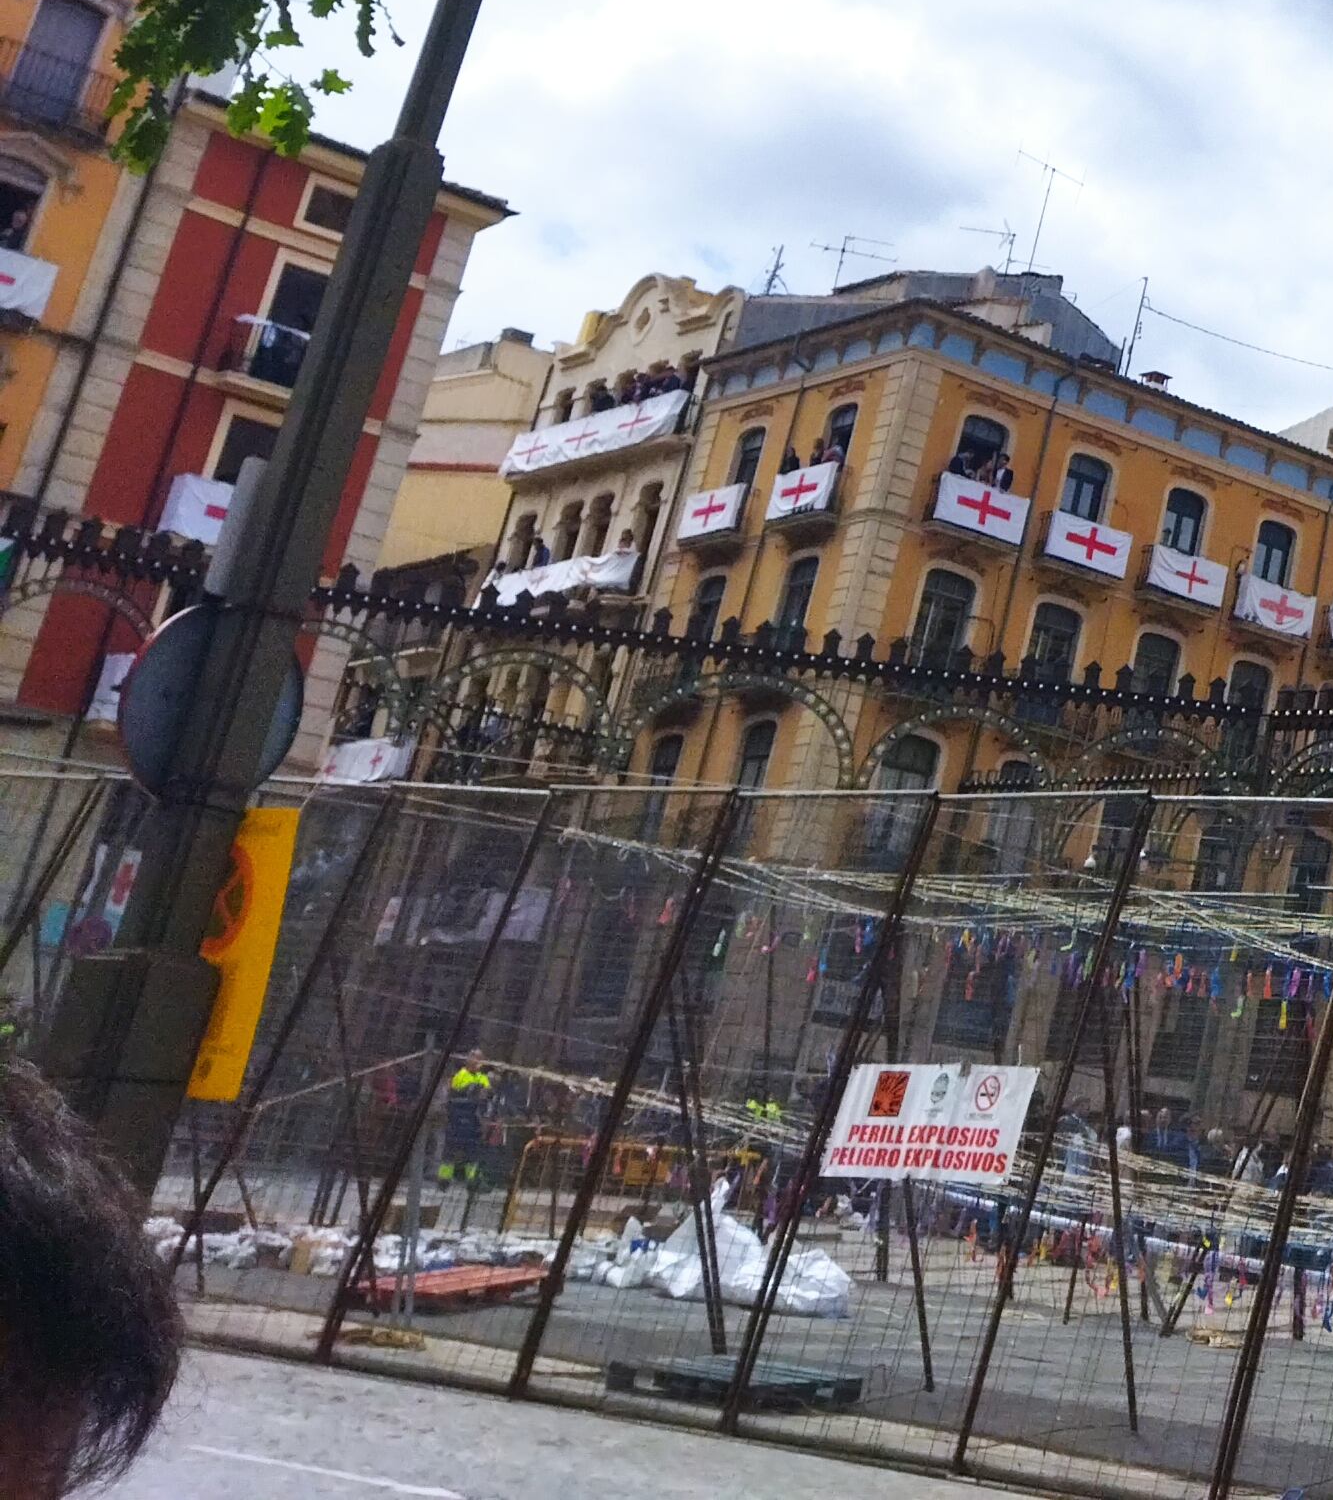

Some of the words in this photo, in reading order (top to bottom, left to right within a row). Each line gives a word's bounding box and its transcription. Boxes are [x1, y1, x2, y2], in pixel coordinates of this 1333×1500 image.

[847, 1124, 904, 1144] PERILL
[907, 1125, 1000, 1148] EXPLOSIUS
[829, 1148, 901, 1168] PELIGRO
[903, 1149, 1008, 1174] EXPLOSIVOS
